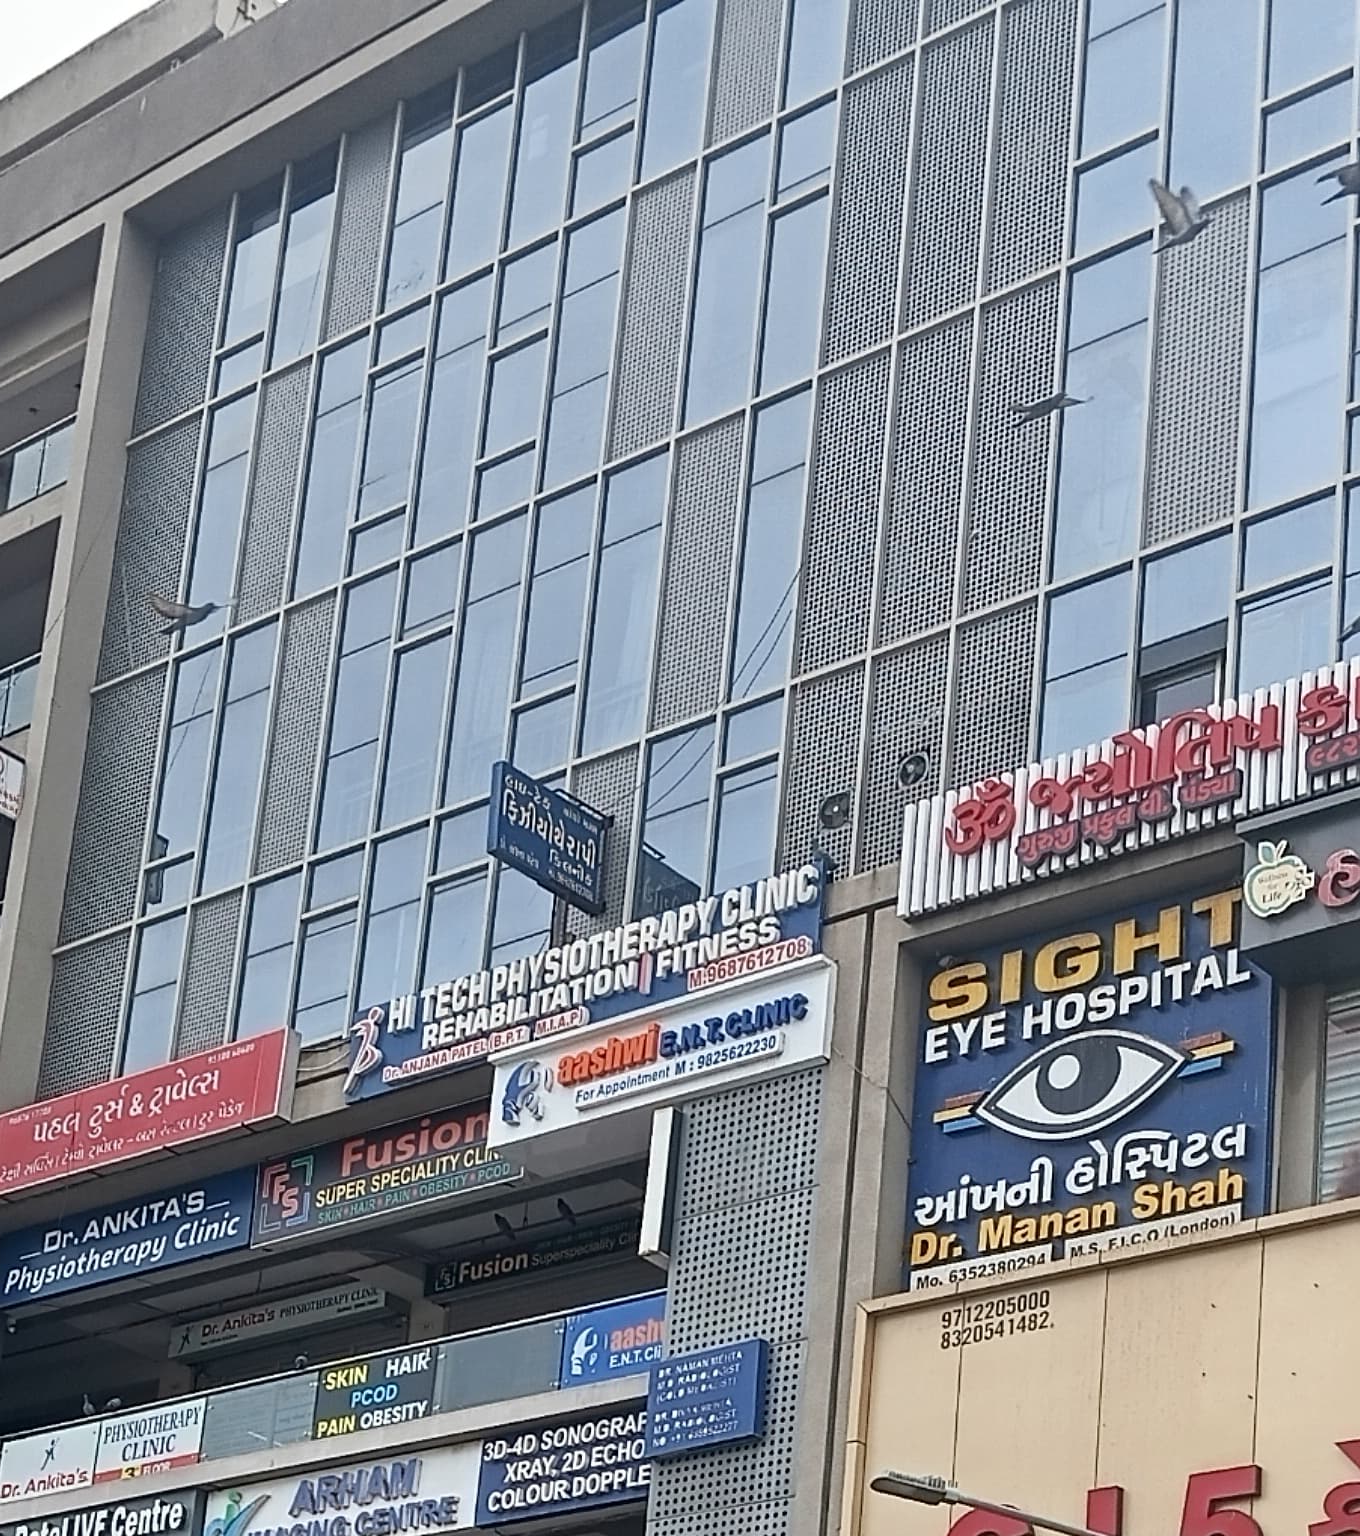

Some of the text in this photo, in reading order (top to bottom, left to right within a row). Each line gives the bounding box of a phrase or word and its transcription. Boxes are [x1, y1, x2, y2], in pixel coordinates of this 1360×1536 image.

[386, 865, 820, 1034] HI TECH PHYSIOTHERAPY CLINIC
[927, 885, 1241, 1023] SIGHT
[421, 917, 780, 1054] REHABILITATION FITNESS
[924, 948, 1251, 1065] EYE HOSPITAL
[31, 1113, 82, 1144] પહલ
[88, 1085, 126, 1137] ટુર્સ
[129, 1094, 144, 1116] &
[146, 1067, 221, 1121] ટ્રાવેલ્સ
[341, 1111, 490, 1177] Fusion
[316, 1154, 461, 1207] SUPER SPECIALITY
[317, 1163, 511, 1224] SKIN HAIR PAIN OBESITY PCOD
[914, 1122, 1247, 1227] આંખની હોસ્પિટલ
[910, 1166, 1244, 1265] Dr. Manan Shah
[3, 1212, 240, 1295] Physiotherapy Clinic
[459, 1233, 617, 1283] Fusion Superspeciality
[941, 1289, 1051, 1331] 9712205000
[325, 1353, 430, 1391] SKIN HAIR
[351, 1384, 398, 1408] PCOD
[103, 1405, 202, 1445] PHYSIOTHERAPY
[317, 1402, 428, 1438] PAIN OBESITY
[121, 1434, 176, 1463] CLINIC
[483, 1434, 537, 1462] 3D-4D
[504, 1438, 645, 1484] XRAY, 2D ECHO
[1, 1468, 88, 1498] Dr. Ankita's
[289, 1457, 422, 1518] ARHAM
[487, 1482, 568, 1514] COLOUR
